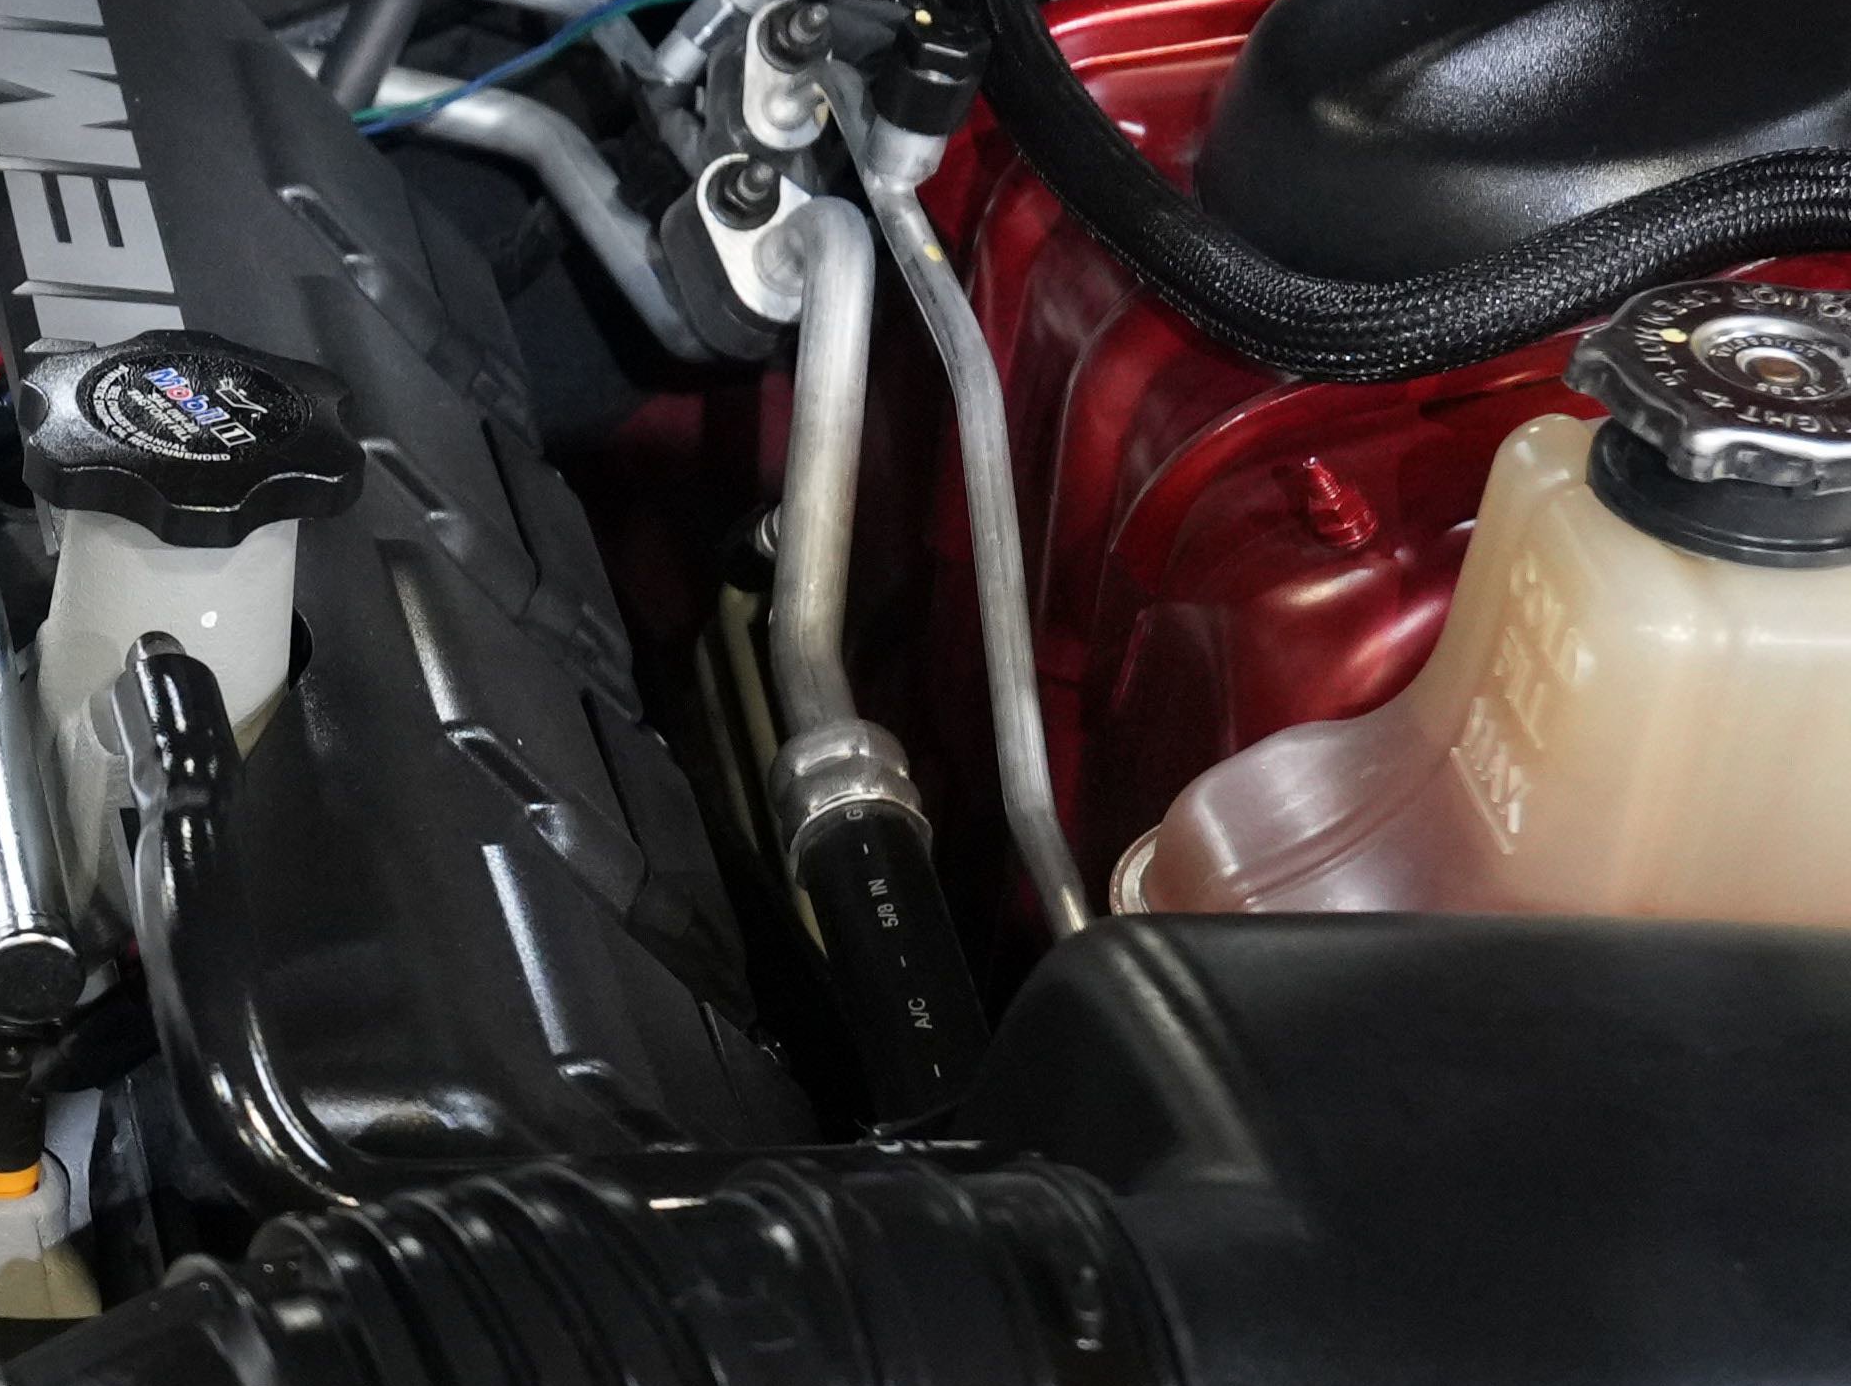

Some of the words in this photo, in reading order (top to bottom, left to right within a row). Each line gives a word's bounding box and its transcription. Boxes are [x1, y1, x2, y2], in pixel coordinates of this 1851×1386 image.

[143, 367, 230, 426] Mobil
[127, 388, 175, 426] FACTORY
[167, 424, 193, 443] FILL
[1737, 405, 1851, 433] IGHT
[127, 434, 231, 462] RECOMMENDED
[134, 431, 188, 452] MANUAL
[868, 878, 887, 899] IN
[877, 903, 900, 929] 5/8
[907, 996, 934, 1030] A/C
